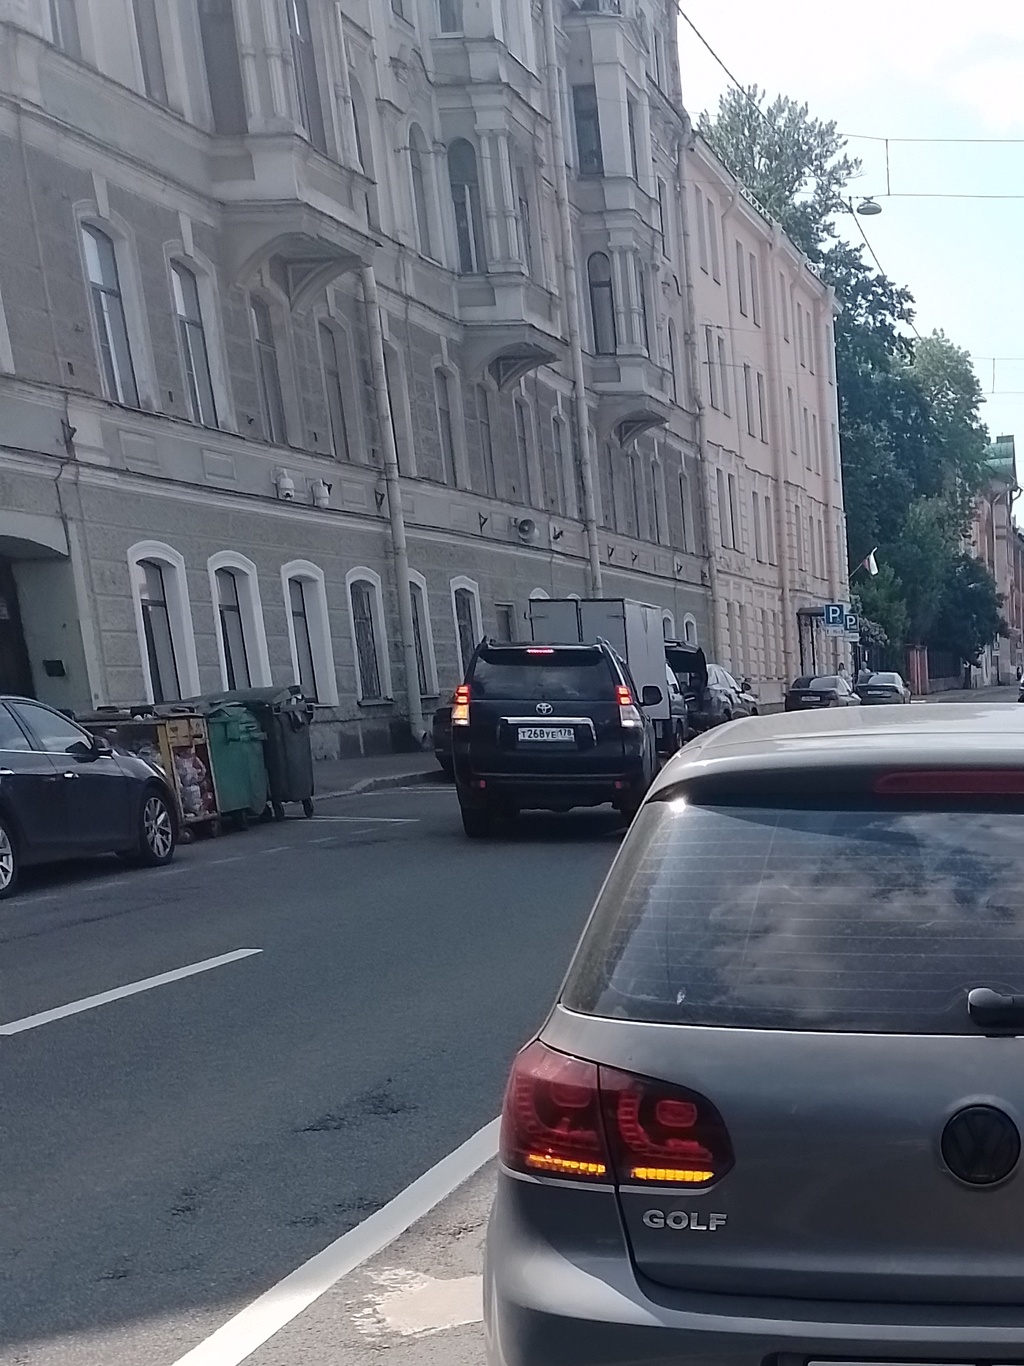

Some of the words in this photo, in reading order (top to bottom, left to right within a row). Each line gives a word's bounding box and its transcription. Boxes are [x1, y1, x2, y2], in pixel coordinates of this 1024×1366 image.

[829, 606, 840, 623] P
[846, 615, 856, 629] P
[642, 1209, 728, 1231] GOLF
